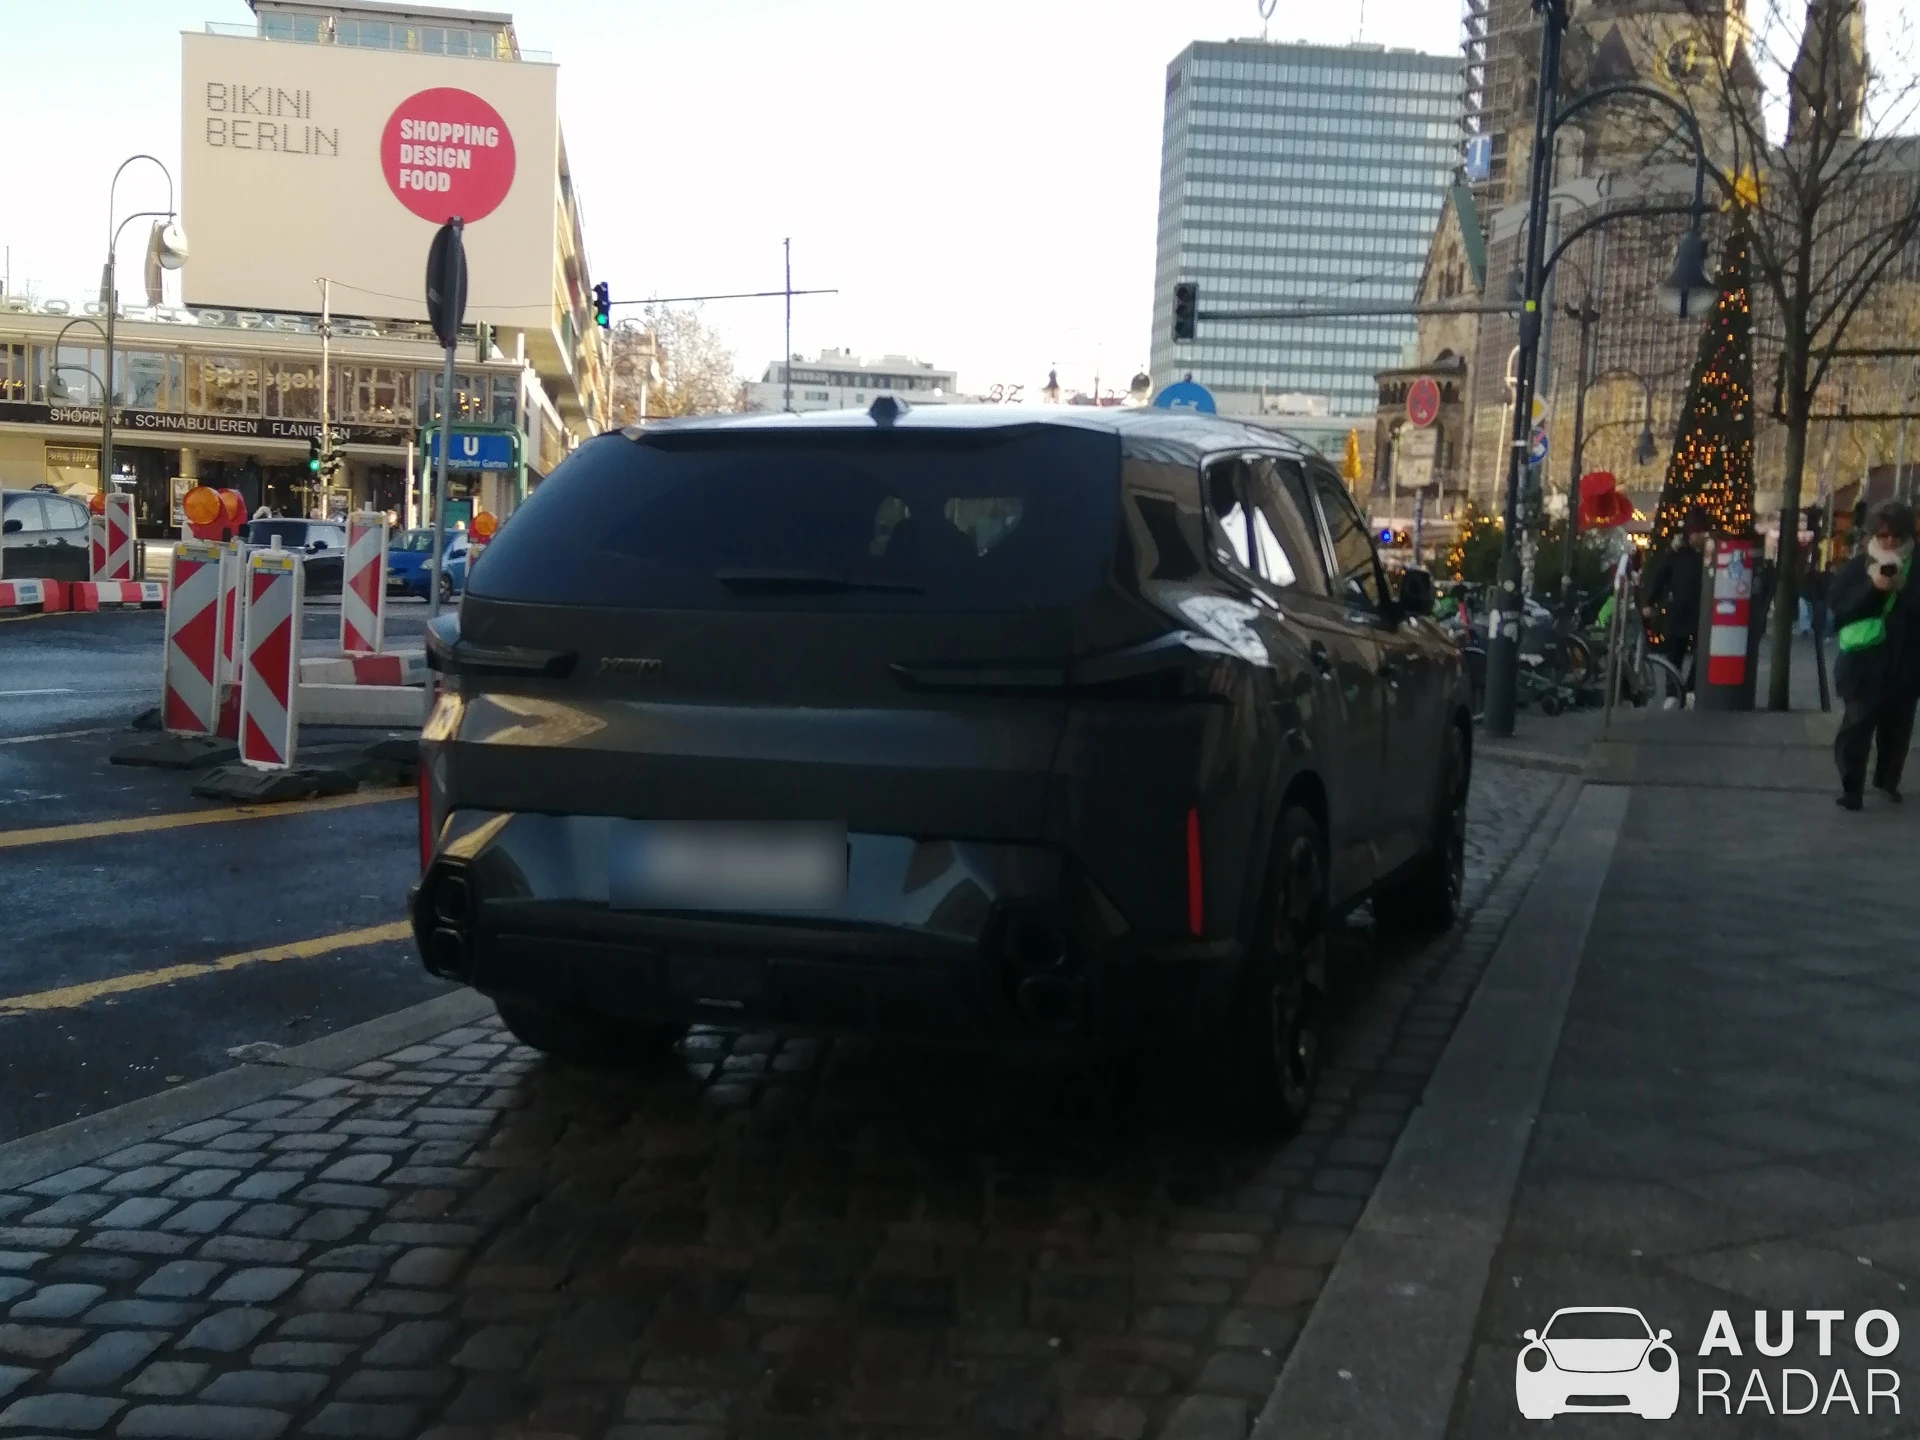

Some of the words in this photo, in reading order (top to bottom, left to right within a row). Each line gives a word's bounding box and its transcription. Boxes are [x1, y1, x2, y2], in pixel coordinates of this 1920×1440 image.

[206, 81, 310, 119] BIKINI
[206, 116, 339, 156] BERLIN
[400, 118, 499, 147] SHOPPING
[400, 145, 471, 169] DESIGN
[400, 168, 450, 192] FOOD
[135, 414, 257, 434] SCHNABULIEREN
[272, 423, 350, 439] FLANIEEN
[463, 436, 479, 456] U
